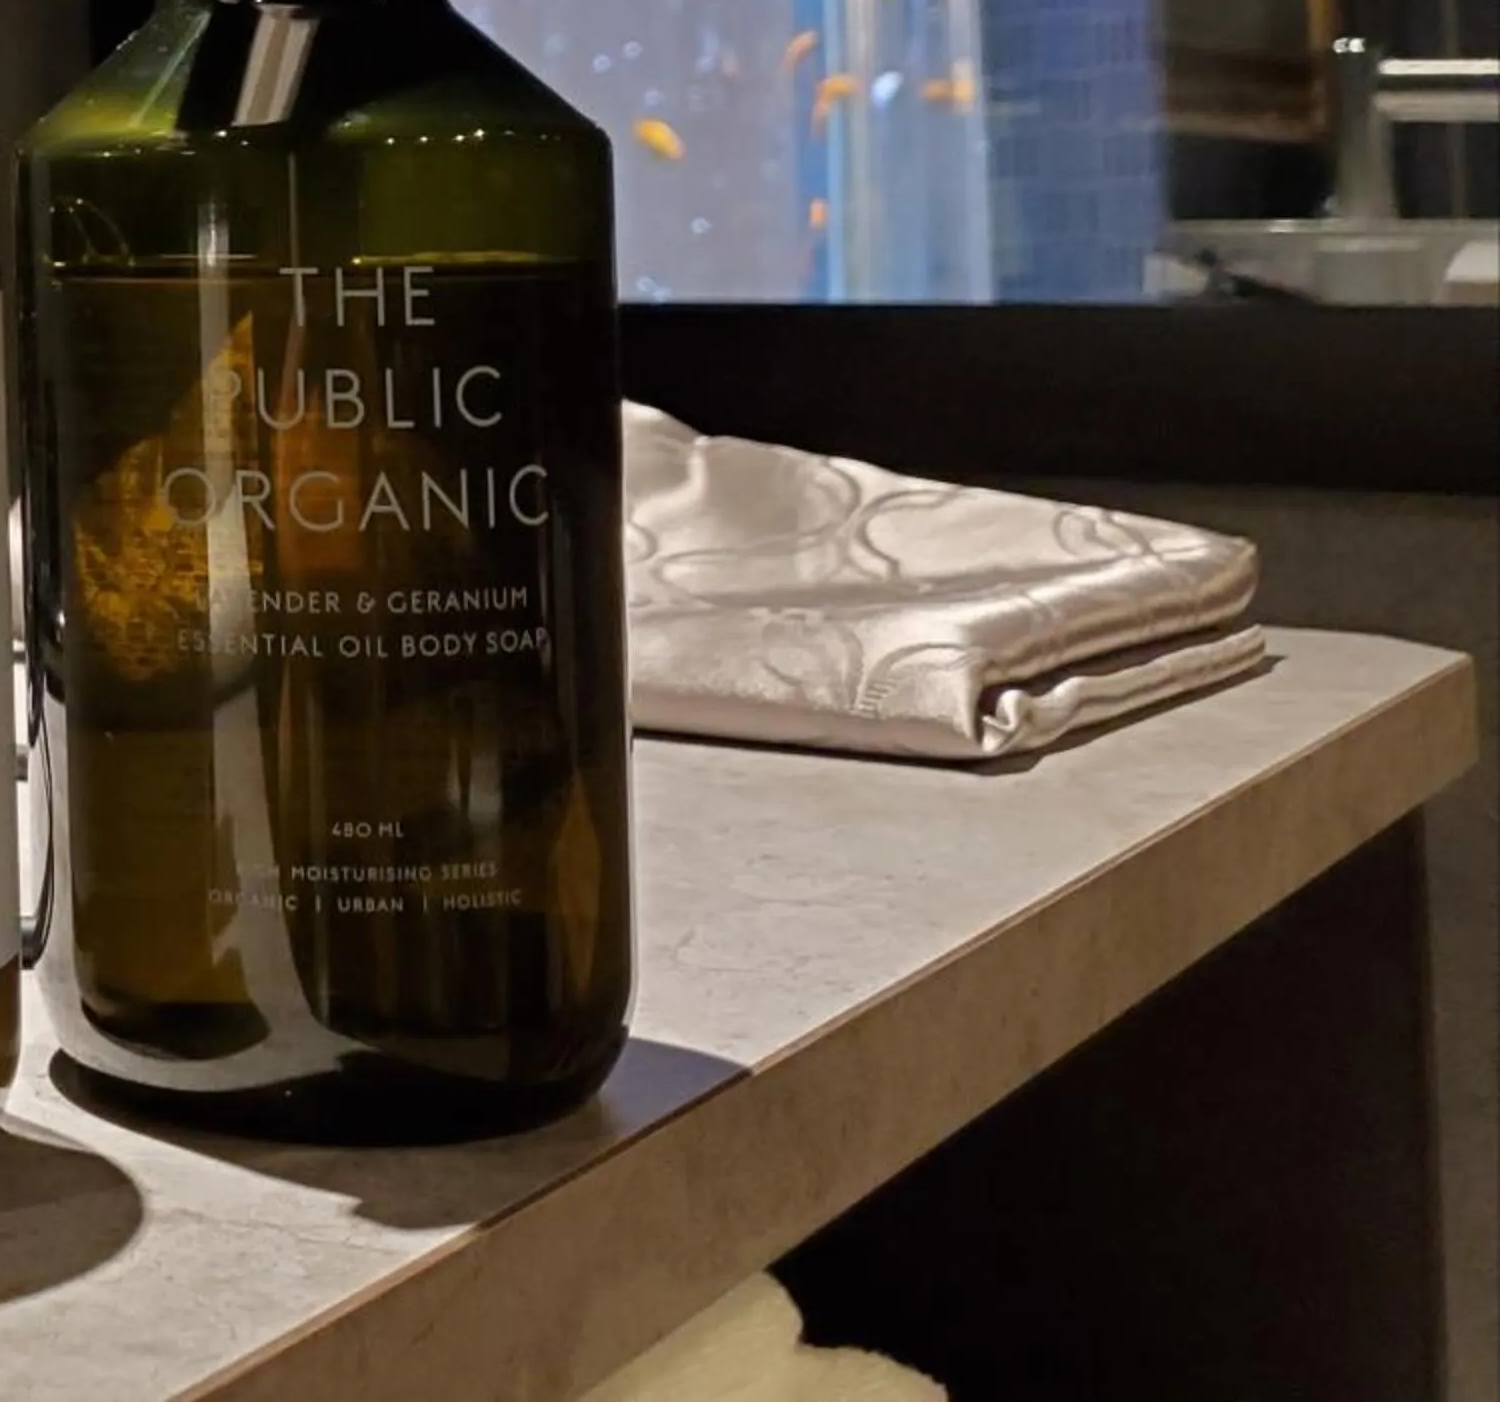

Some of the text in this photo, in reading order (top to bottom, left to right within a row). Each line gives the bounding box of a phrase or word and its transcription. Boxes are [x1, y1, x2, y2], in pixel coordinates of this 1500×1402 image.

[279, 266, 435, 326] THE
[210, 365, 503, 431] PUBLIC
[162, 464, 549, 533] ORGANIC
[195, 586, 529, 615] LENDER & GERANIUM
[338, 635, 389, 659] OIL
[401, 631, 478, 659] BODY
[485, 626, 549, 655] SOAP
[330, 822, 405, 839] 480 ML
[290, 864, 432, 885] MOISTURISING
[440, 861, 498, 880] SERIES
[336, 896, 405, 914] URBAN
[443, 888, 522, 912] HOLISTIC
